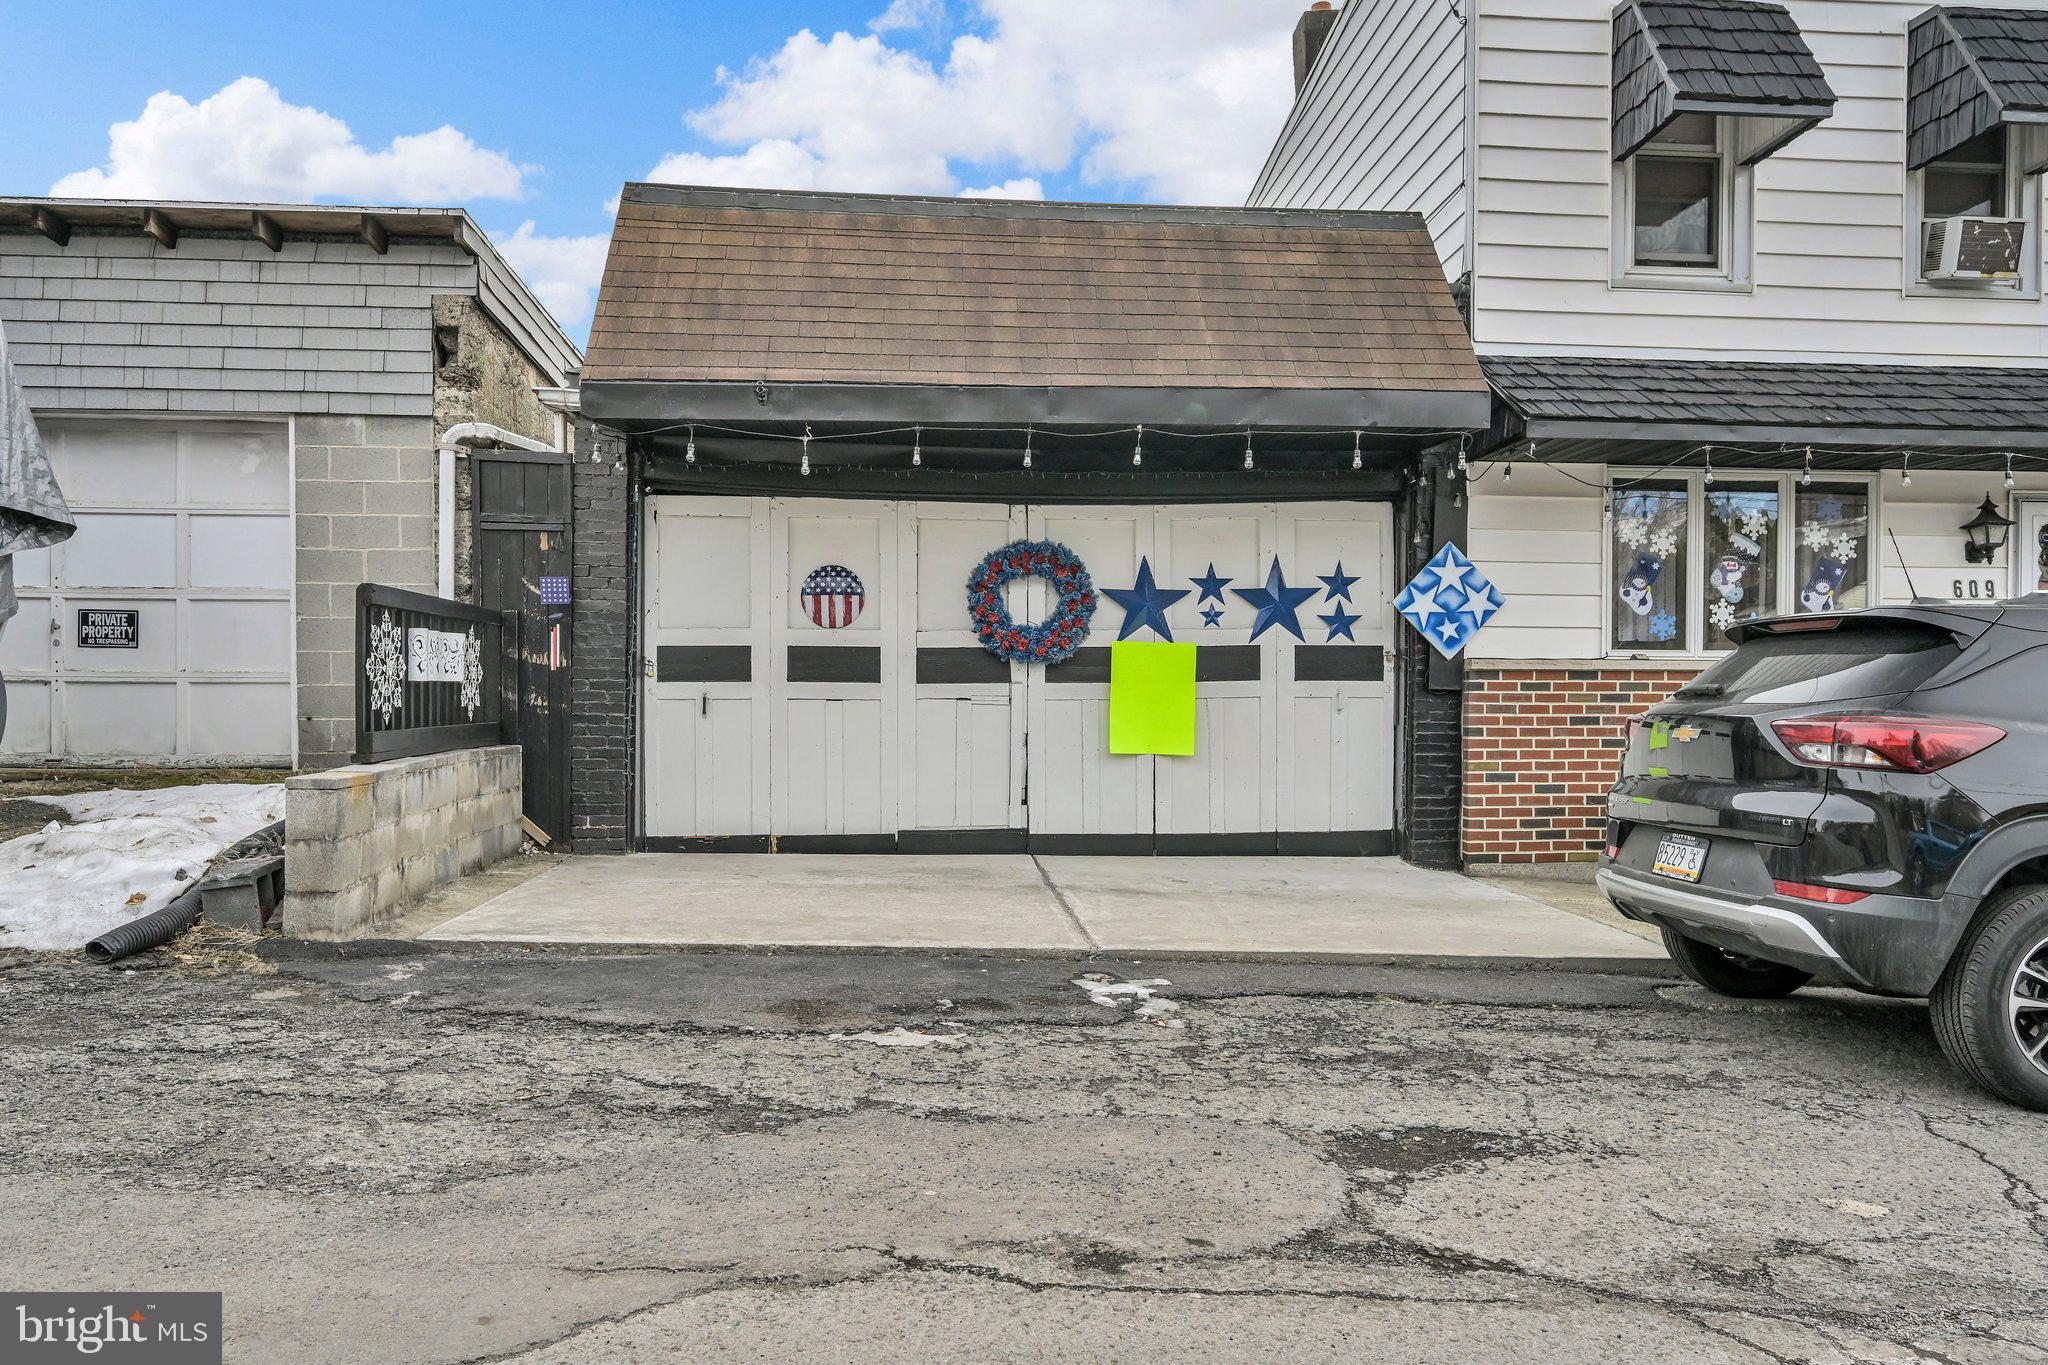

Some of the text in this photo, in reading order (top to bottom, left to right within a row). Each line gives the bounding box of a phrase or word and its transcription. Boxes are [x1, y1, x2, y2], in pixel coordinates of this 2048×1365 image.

[1953, 579, 1995, 598] 609
[88, 613, 128, 626] PRIVATE
[82, 625, 134, 639] PROPERTY
[1782, 818, 1794, 826] LT
[1672, 833, 1696, 841] OUTTEN
[1656, 843, 1687, 867] 85229
